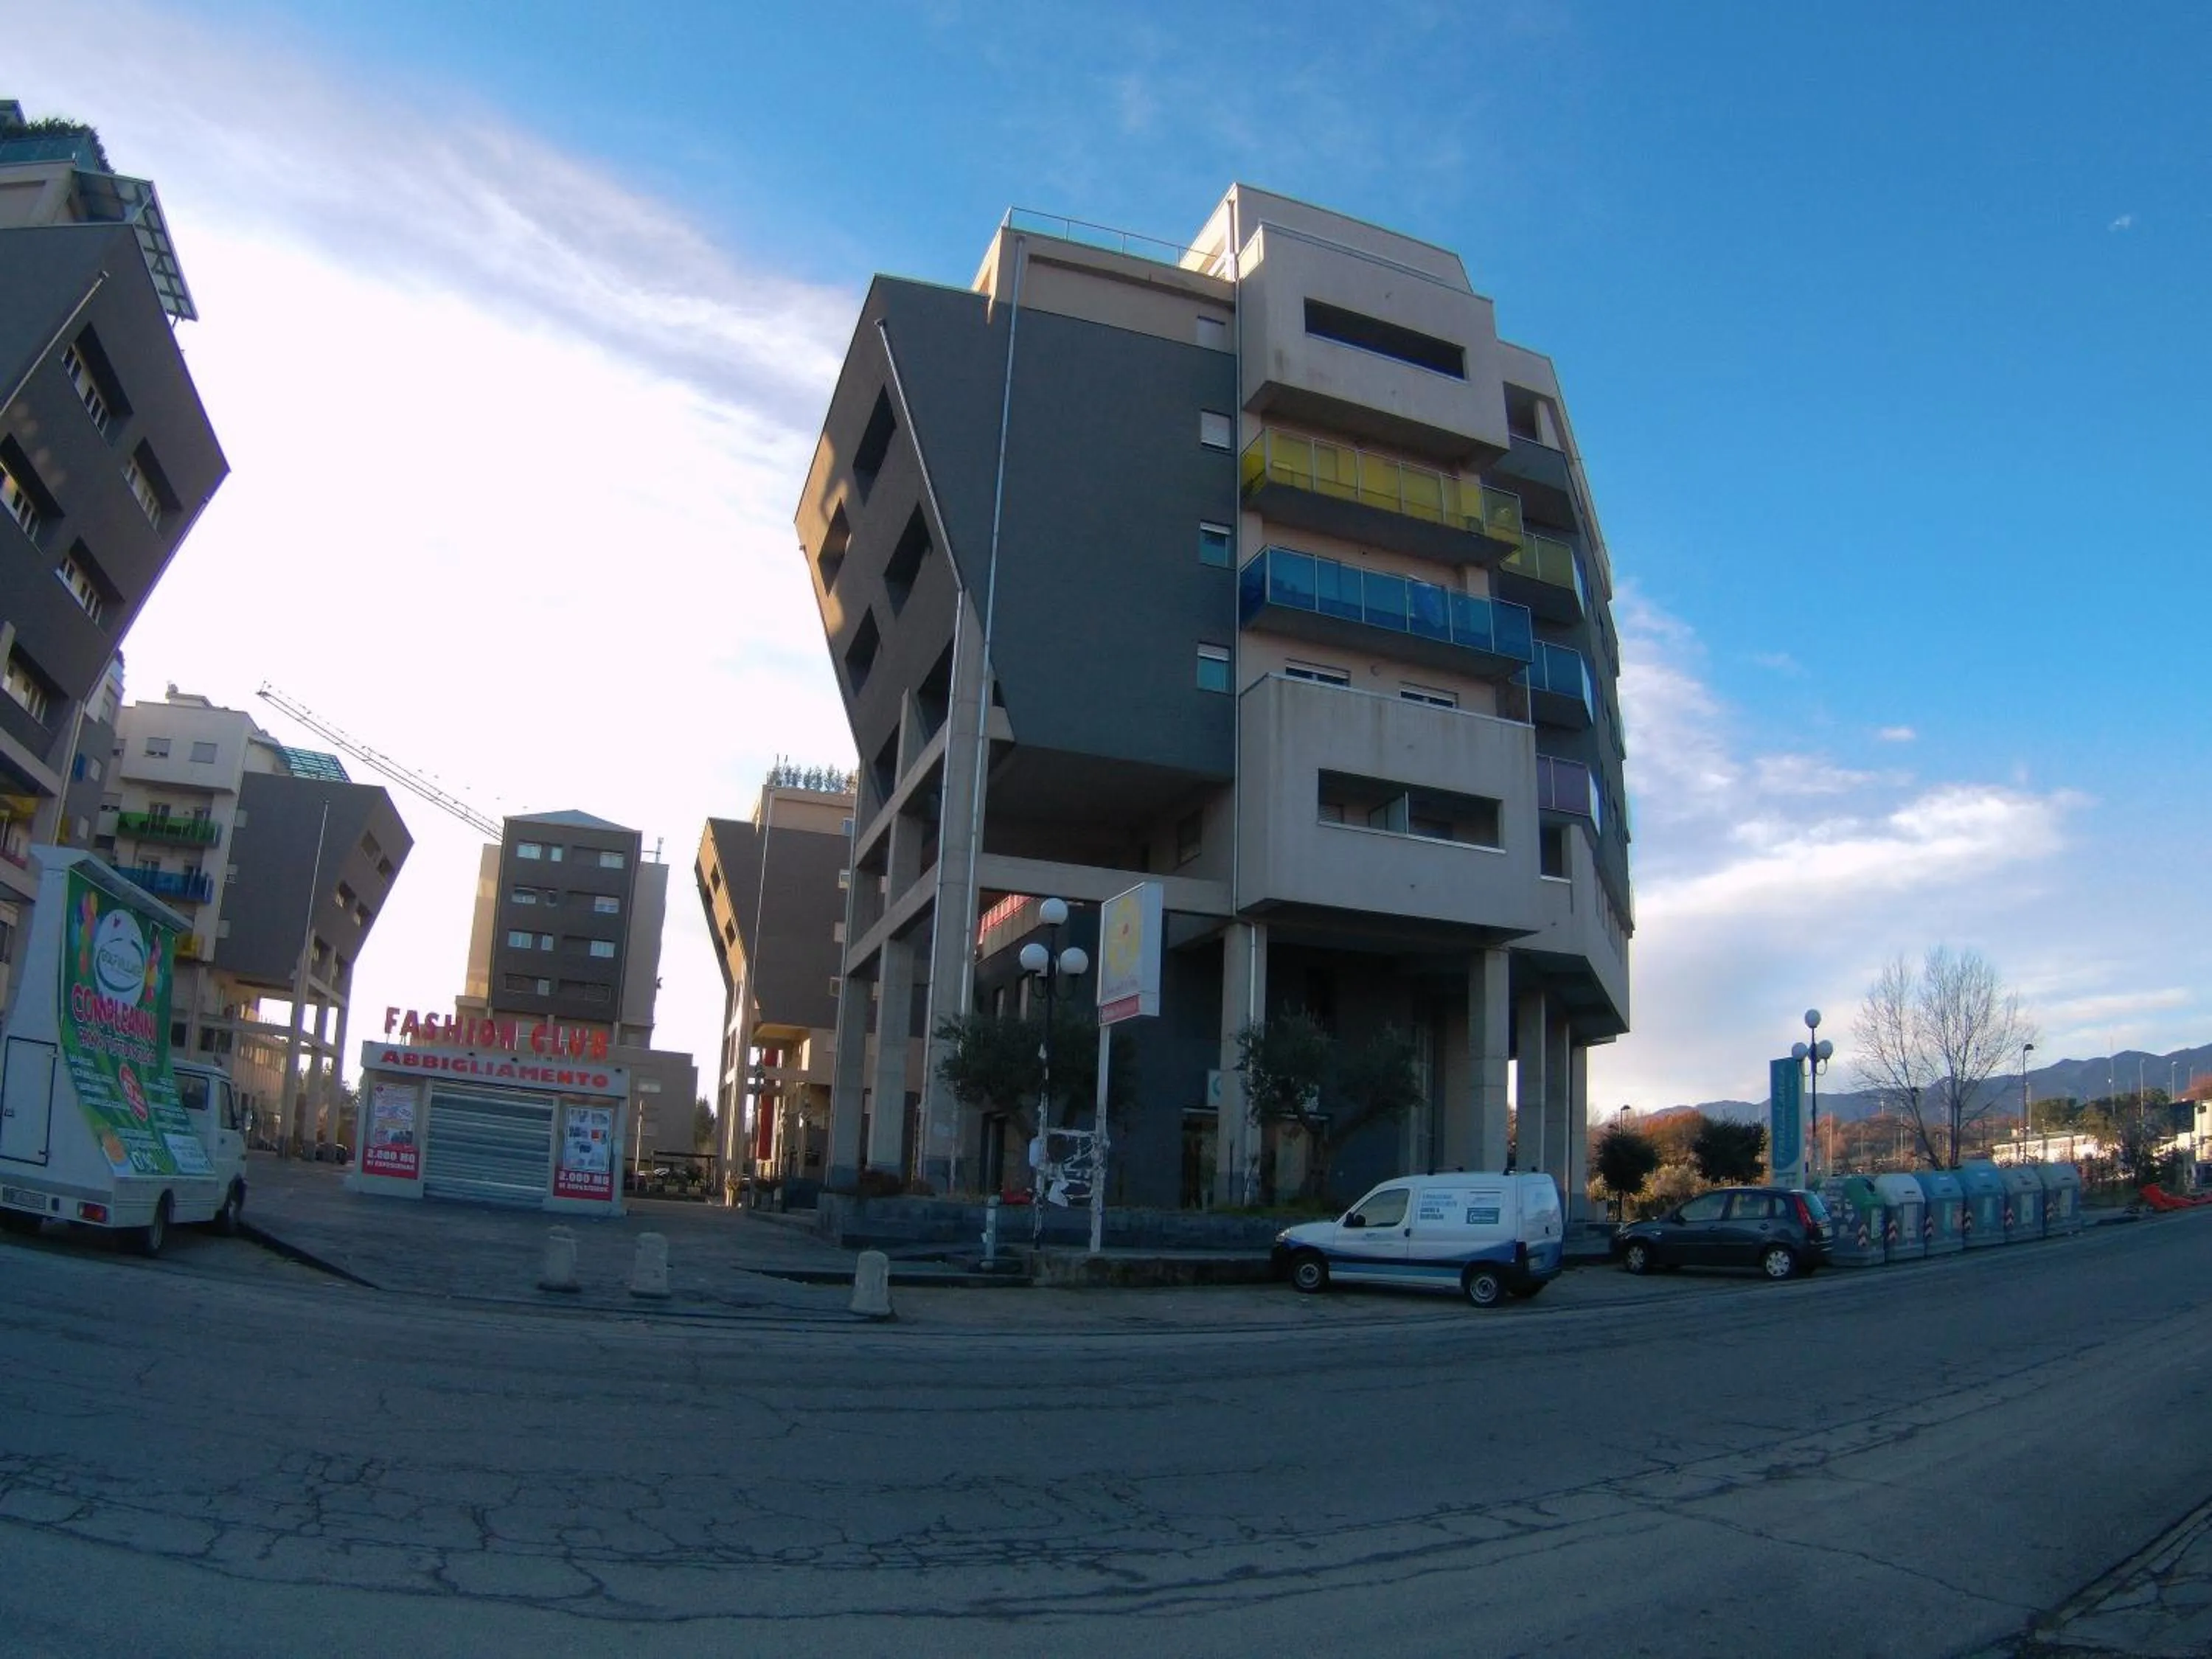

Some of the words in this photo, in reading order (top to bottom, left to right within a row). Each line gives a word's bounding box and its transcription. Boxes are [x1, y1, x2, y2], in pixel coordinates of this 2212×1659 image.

[384, 1006, 518, 1051] FASHION
[531, 1023, 608, 1060] CLUB
[380, 1049, 609, 1092] ABBIGLIAMENTO
